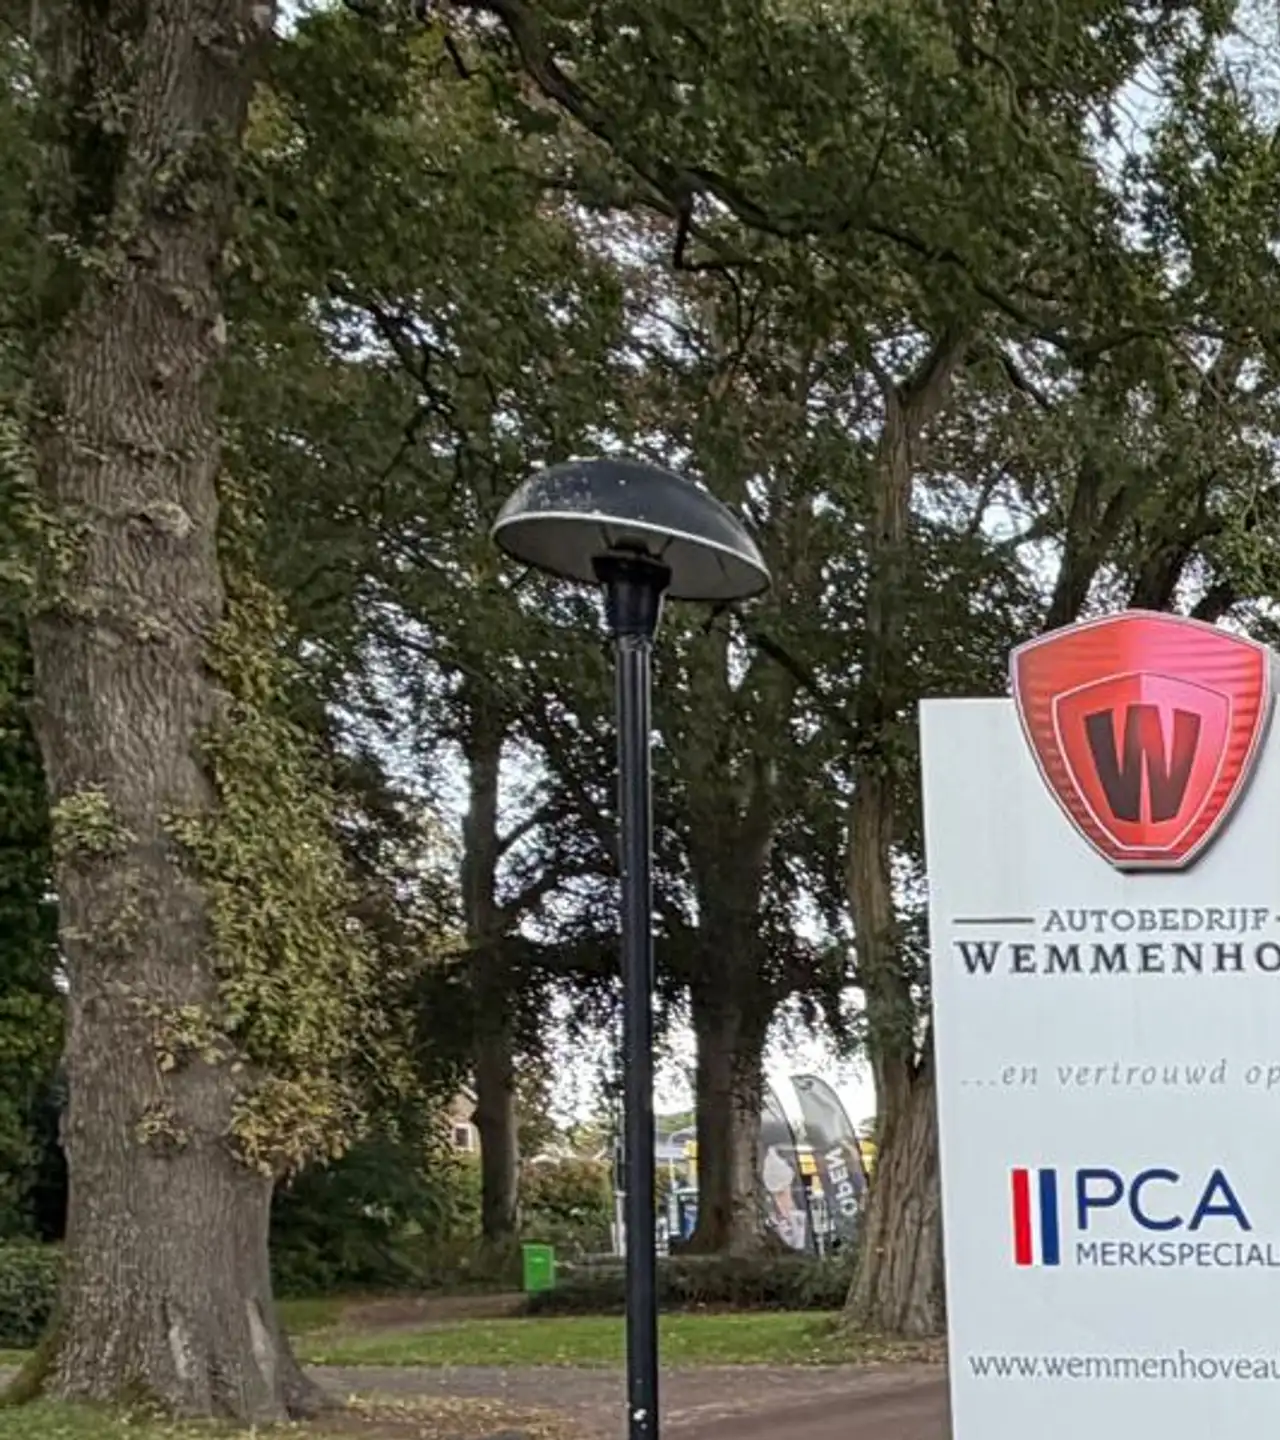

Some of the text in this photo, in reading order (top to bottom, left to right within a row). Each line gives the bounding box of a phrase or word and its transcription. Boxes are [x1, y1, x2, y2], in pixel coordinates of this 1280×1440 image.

[1084, 703, 1203, 825] W
[1042, 907, 1271, 934] AUTOBEDRIJF
[1056, 1058, 1228, 1087] vertrouwd
[1074, 1168, 1253, 1233] PCA
